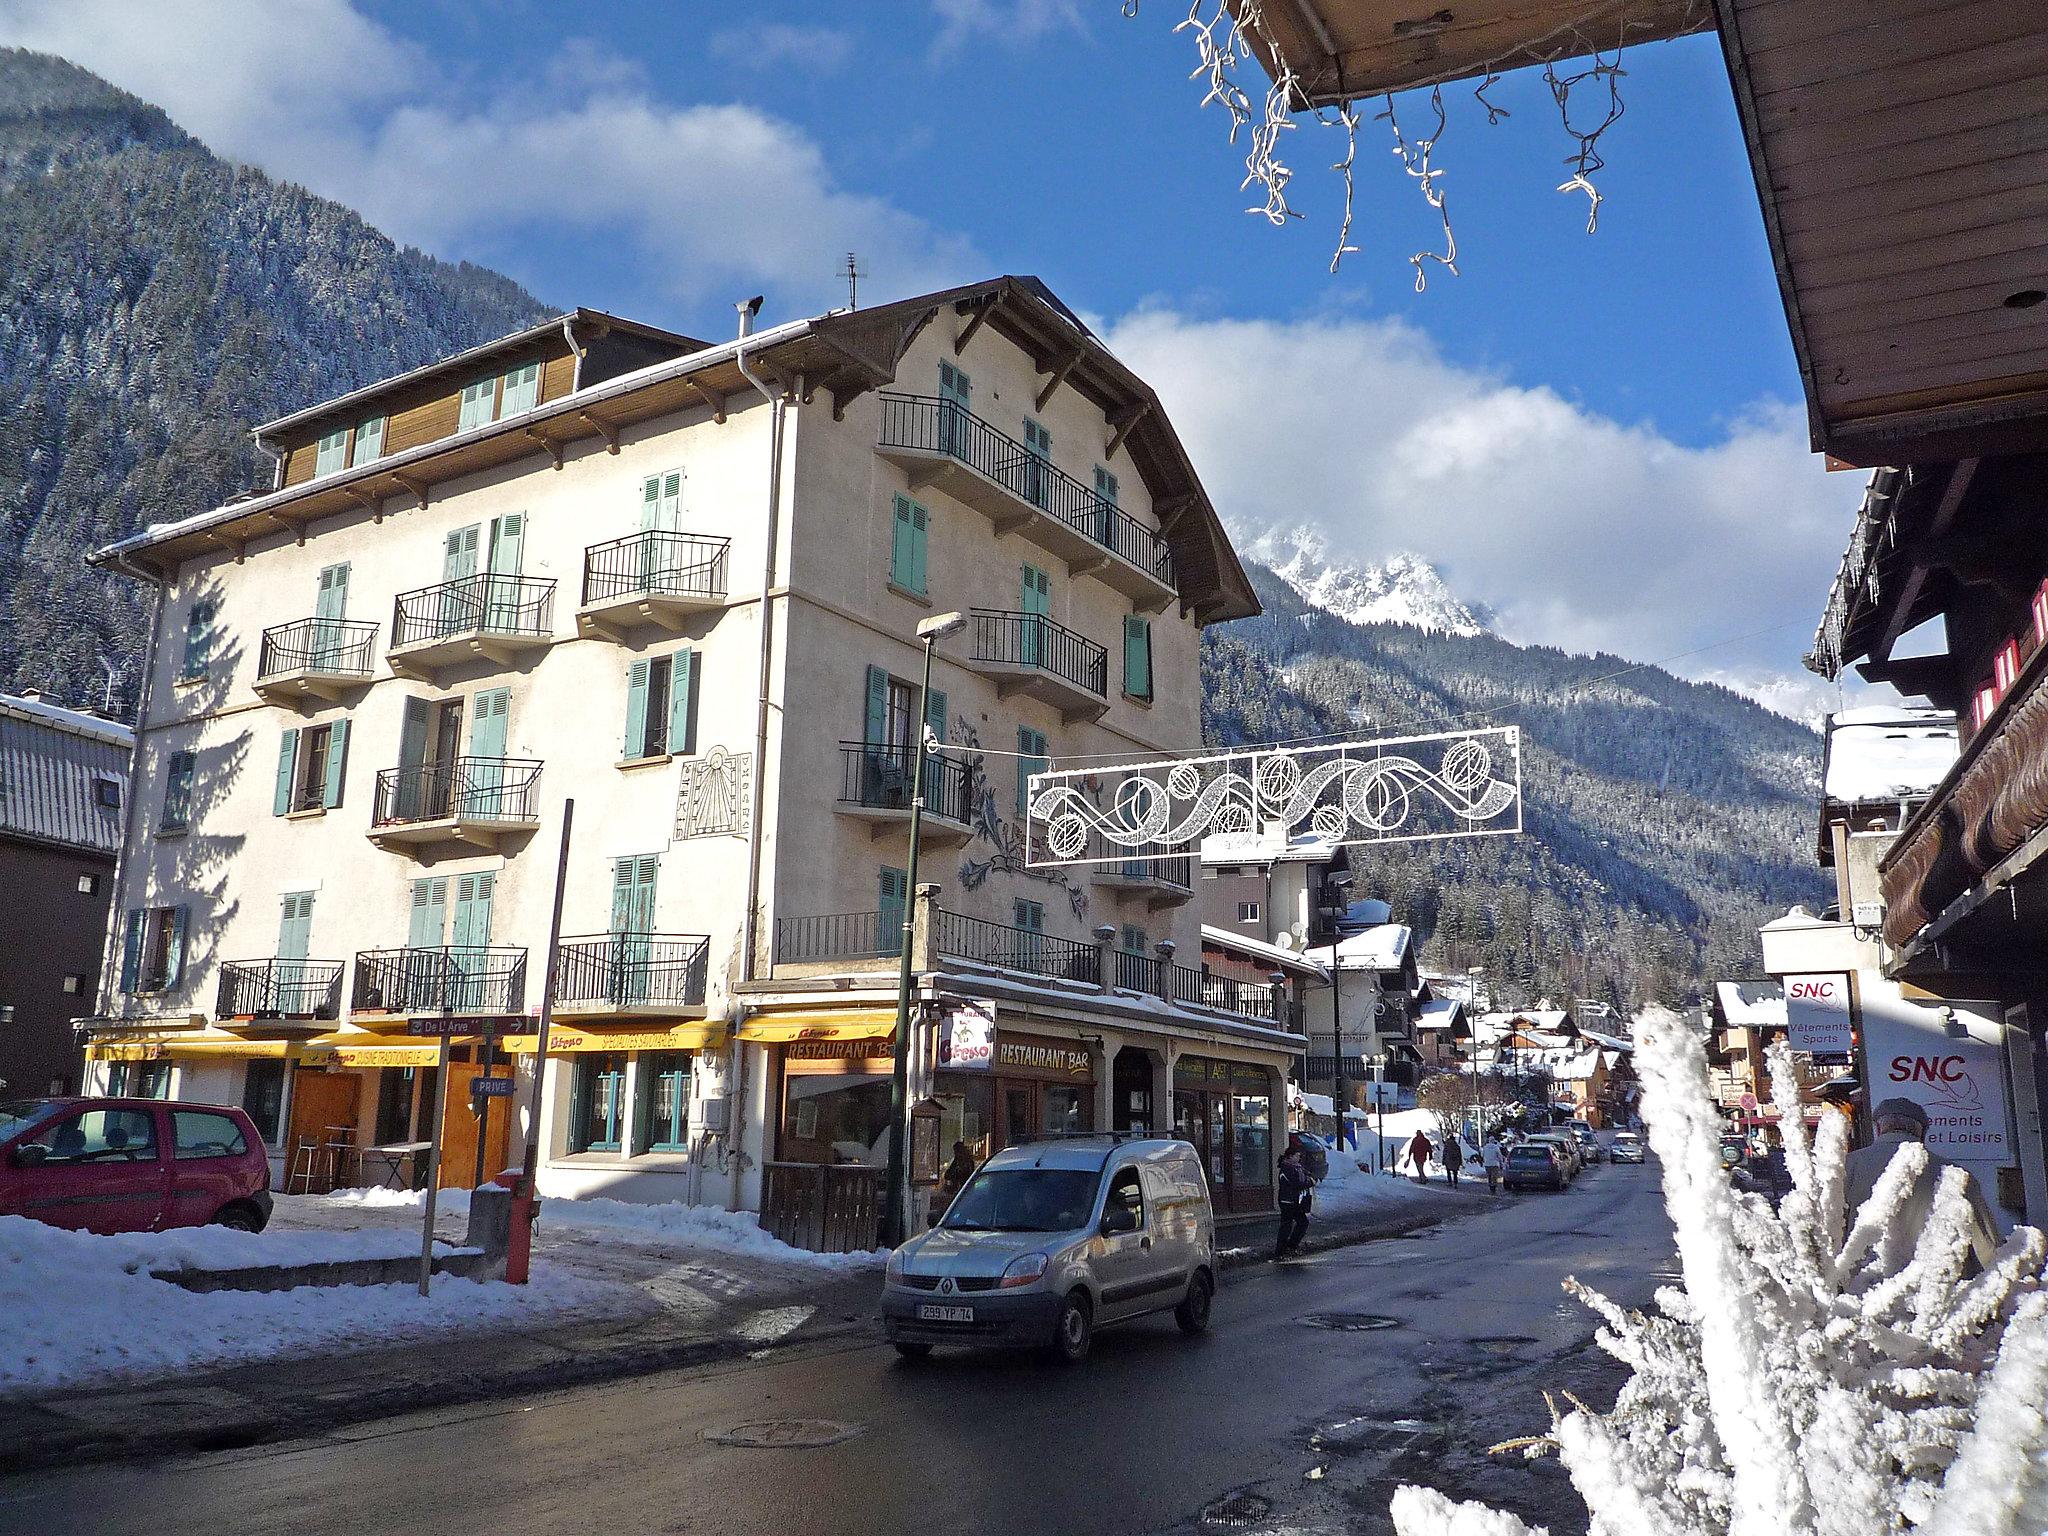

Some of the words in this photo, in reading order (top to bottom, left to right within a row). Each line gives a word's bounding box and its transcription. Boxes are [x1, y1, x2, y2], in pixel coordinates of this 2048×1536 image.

[1790, 982, 1834, 998] SNC
[425, 1021, 437, 1032] De
[1789, 1023, 1849, 1032] Vêtements
[1803, 1034, 1838, 1044] Sports
[788, 1042, 873, 1060] RESTAURANT
[1000, 1044, 1066, 1069] RESTAURANT
[1068, 1052, 1089, 1069] BAR
[1888, 1055, 1966, 1082] SNC
[1928, 1115, 1982, 1127] ements
[1928, 1132, 1943, 1143] et
[1948, 1131, 2002, 1143] Loisirs
[944, 1307, 956, 1319] YP
[960, 1308, 971, 1320] 74
